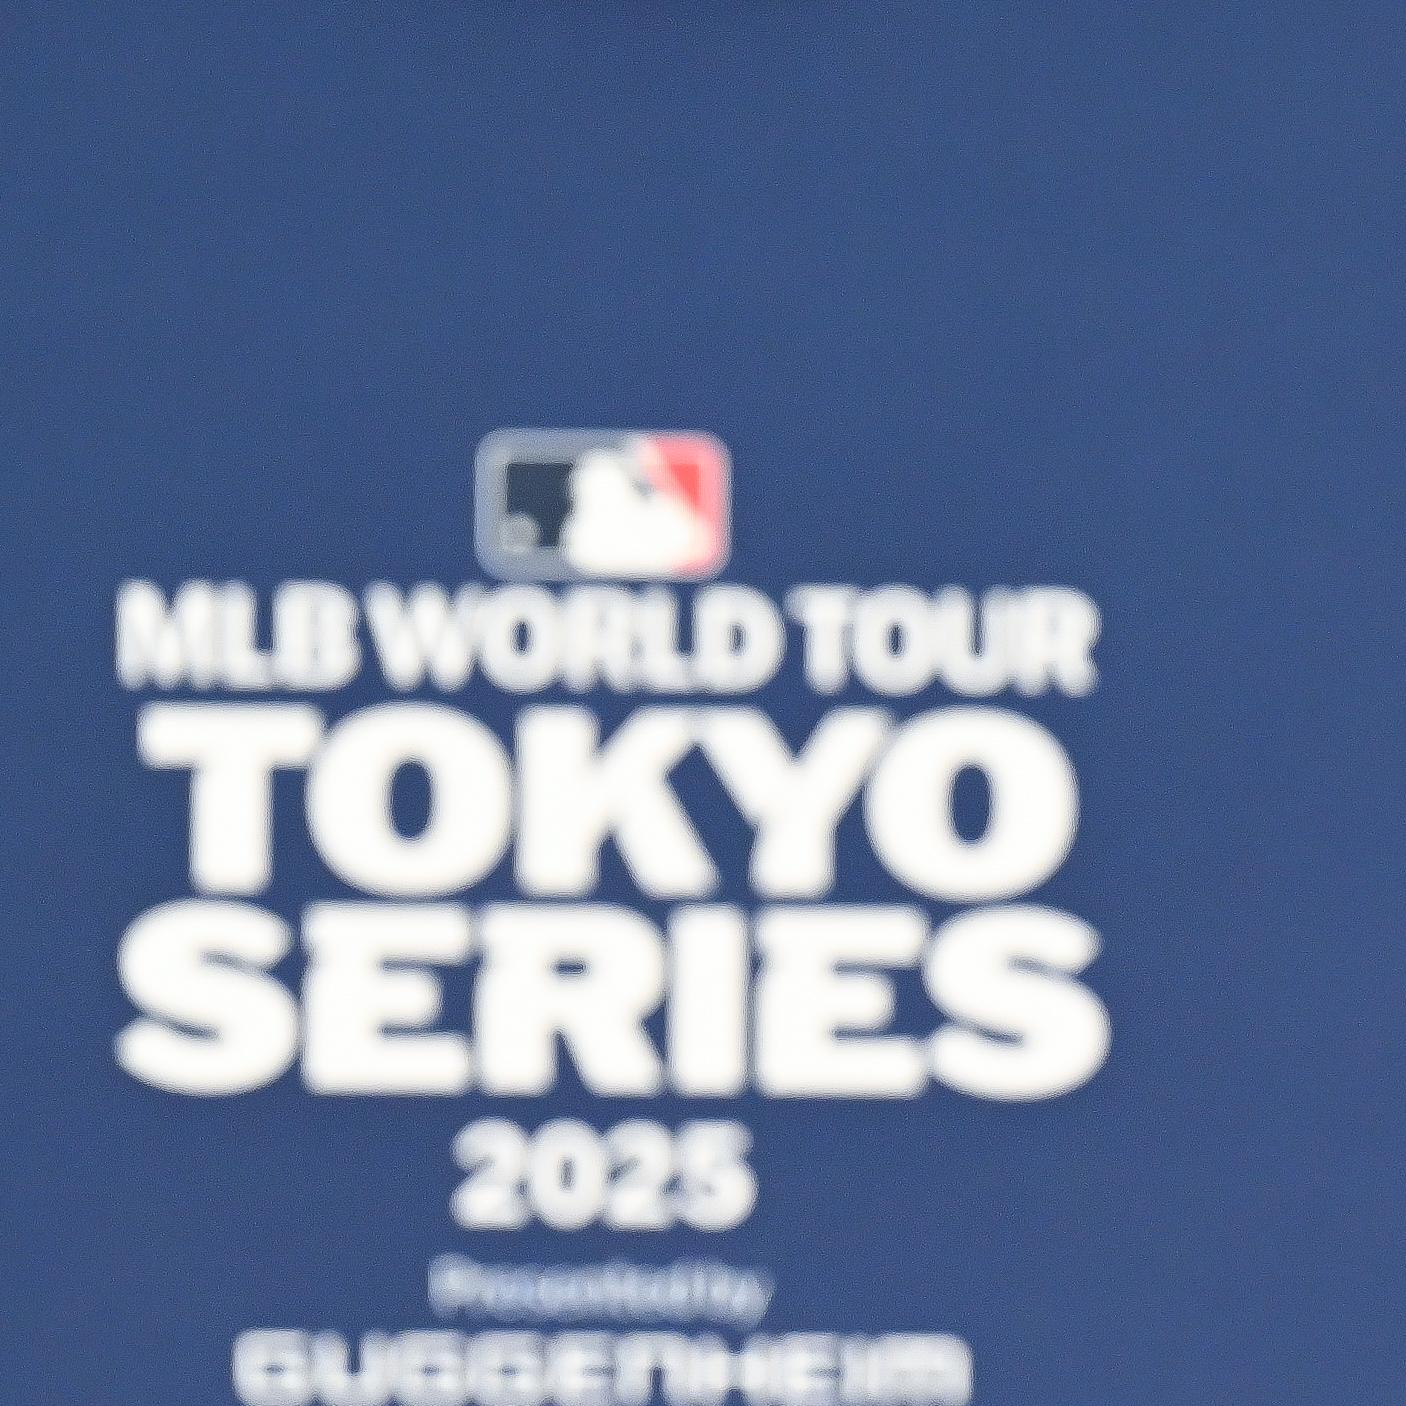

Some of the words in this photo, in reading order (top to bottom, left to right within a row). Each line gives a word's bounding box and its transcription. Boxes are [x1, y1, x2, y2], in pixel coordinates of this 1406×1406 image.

[115, 579, 361, 692] MLB
[363, 581, 785, 696] WORLD
[788, 584, 1101, 698] TOUR
[136, 701, 1080, 900] TOKYO
[115, 899, 1113, 1102] SERIES
[450, 1117, 758, 1232] 2025
